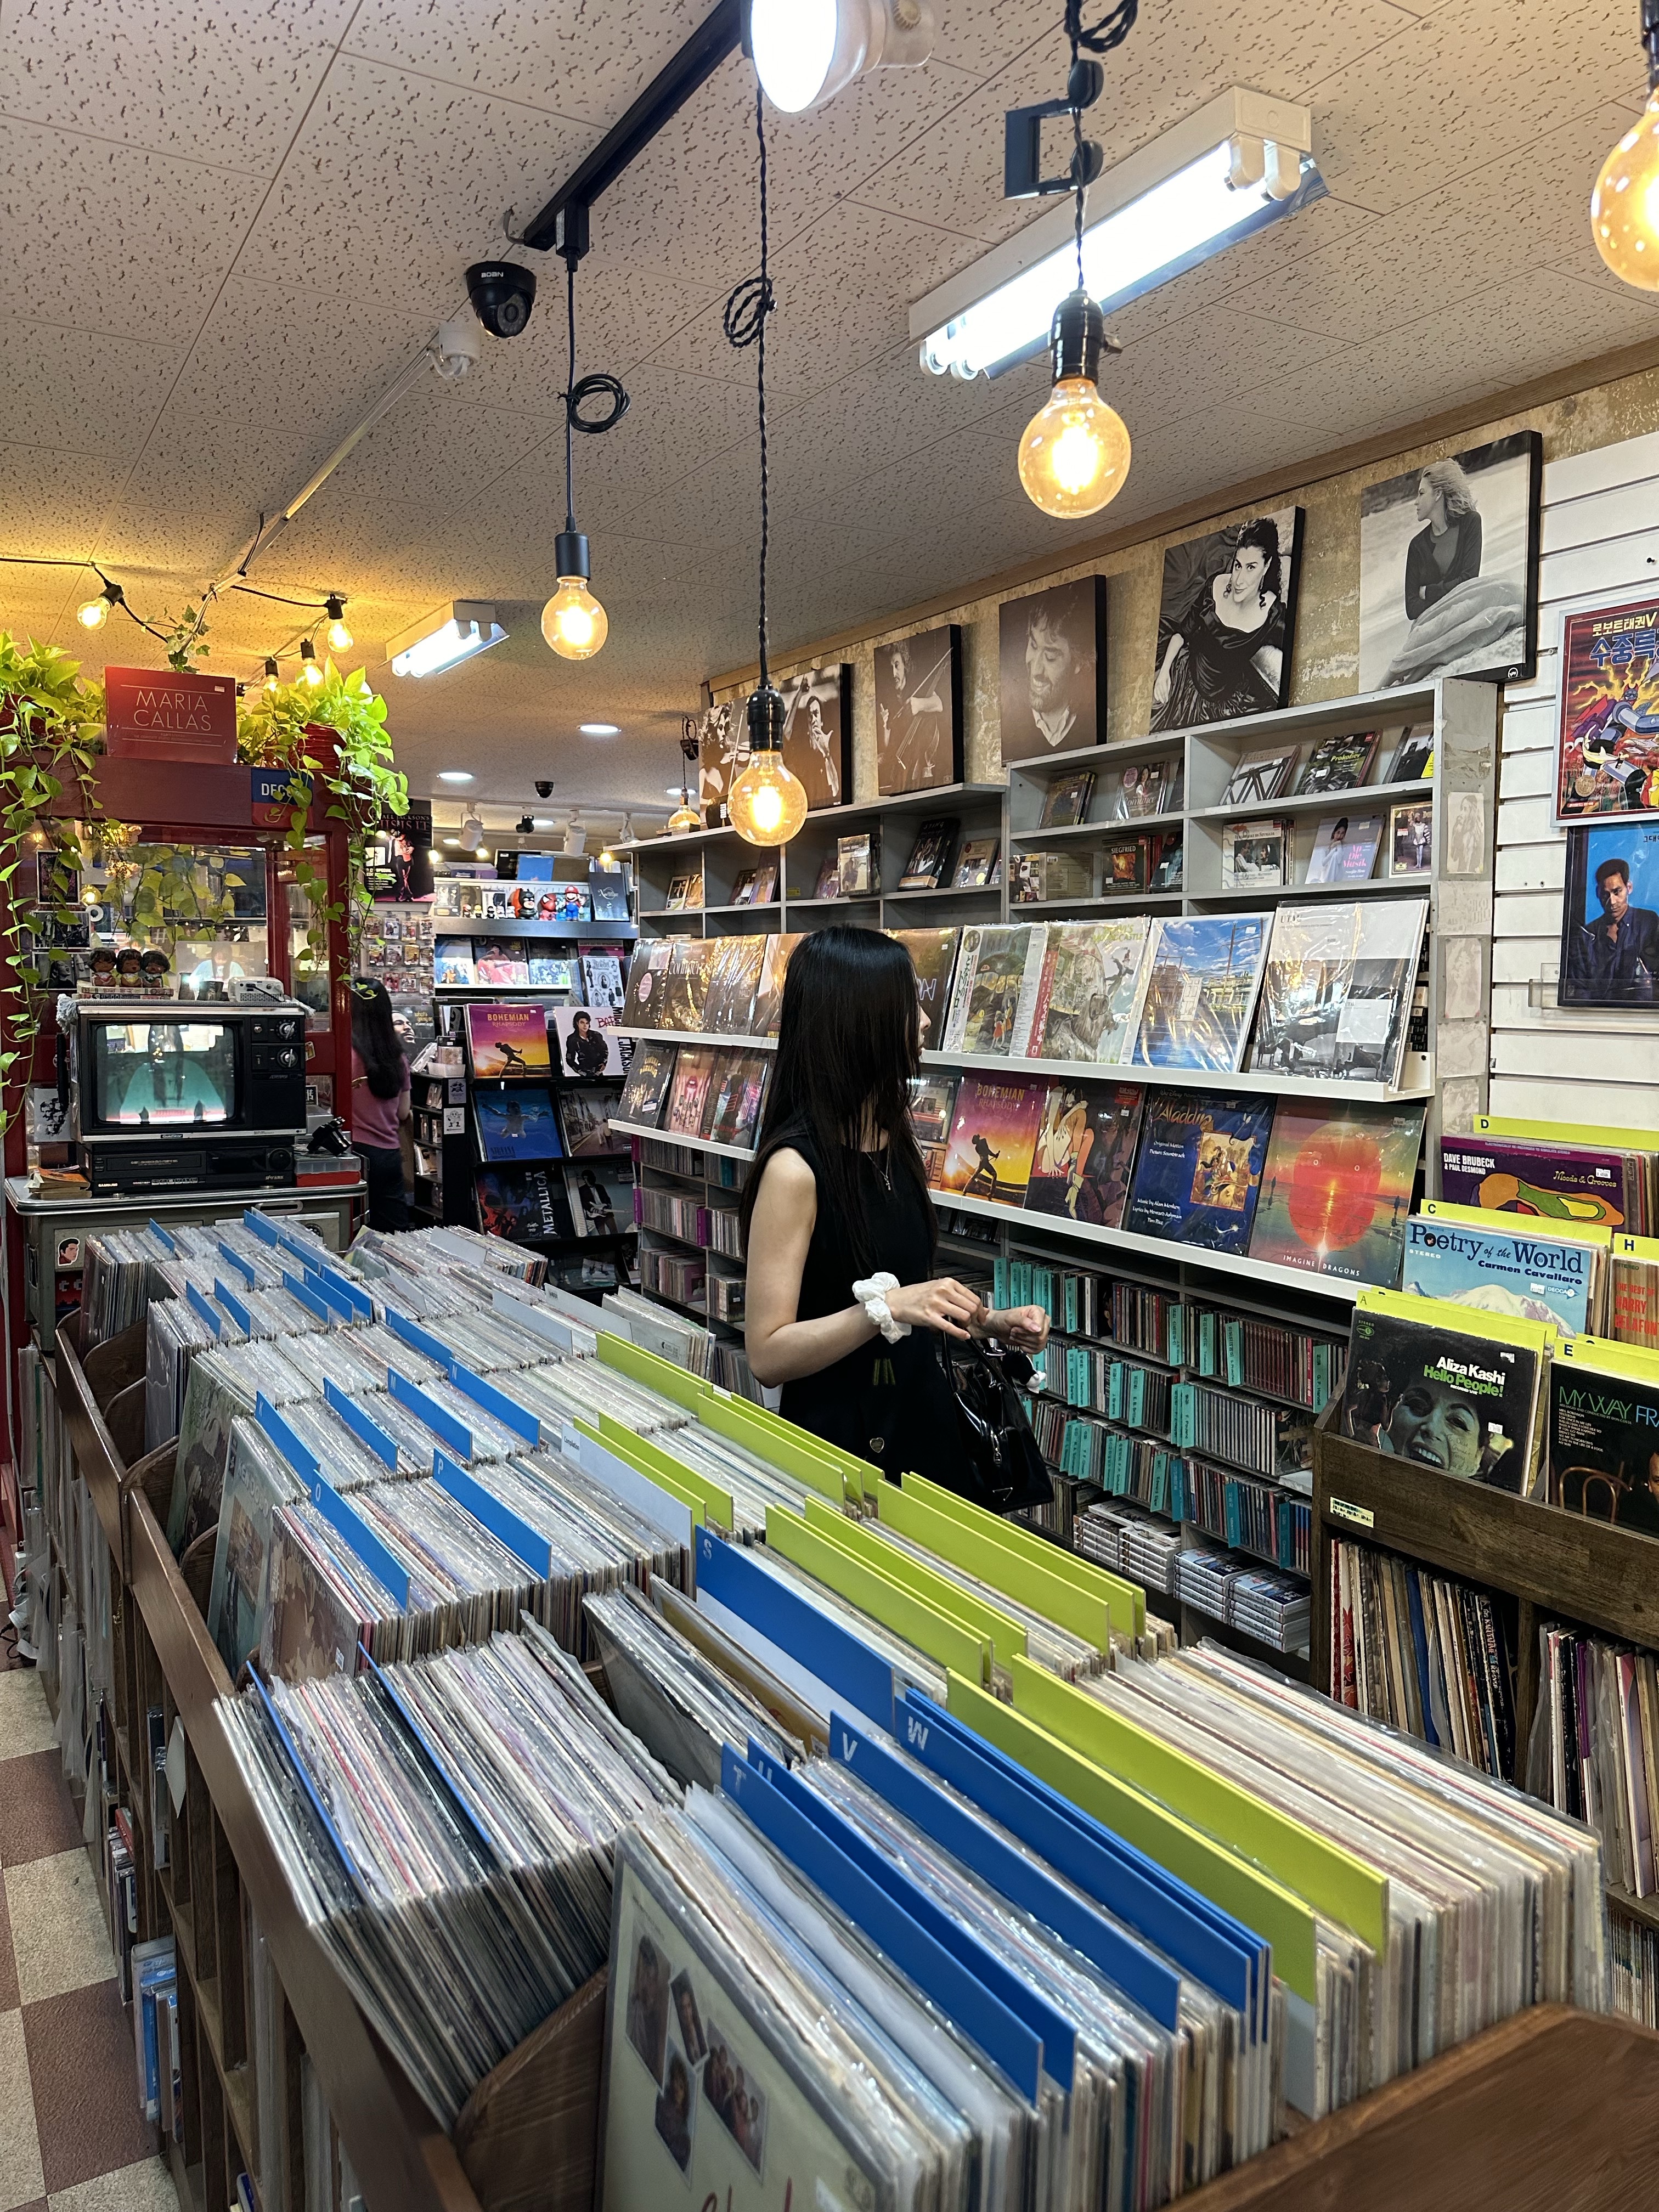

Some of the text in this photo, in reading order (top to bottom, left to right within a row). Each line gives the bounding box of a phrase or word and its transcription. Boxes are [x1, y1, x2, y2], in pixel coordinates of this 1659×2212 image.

[1592, 612, 1657, 636] 로보트태권V
[1589, 629, 1659, 668] 수중특
[136, 690, 207, 712] MARIA
[134, 709, 211, 731] CALLAS
[1331, 753, 1362, 762] Prokofiev
[1111, 845, 1137, 854] SIEGFRIED
[977, 1083, 1025, 1102] BOHEMIAN
[979, 1098, 1017, 1111] RHAPSODY
[1158, 1100, 1213, 1126] Aladdin
[1481, 1120, 1489, 1128] D
[1154, 1141, 1169, 1149] Original
[1443, 1153, 1495, 1169] DAVE BRUBECK
[1462, 1166, 1486, 1175] DESMOND
[1553, 1171, 1617, 1187] Moods & Grooves
[534, 1171, 557, 1235] METALLICA
[1164, 1202, 1180, 1210] Menken
[1427, 1204, 1436, 1214] C
[1409, 1223, 1583, 1274] Poetry of the World
[1624, 1239, 1634, 1251] H
[1409, 1249, 1441, 1259] STEREO
[1283, 1255, 1360, 1277] IMAGINE DRAGONS
[1478, 1260, 1583, 1285] Carmen Cavallaro
[1548, 1286, 1567, 1294] DECCA
[1617, 1283, 1655, 1297] THE BEST OF
[1360, 1295, 1367, 1305] A
[1615, 1295, 1647, 1314] HARRY
[1615, 1314, 1659, 1336] BELAFON
[1564, 1344, 1573, 1357] E
[452, 1365, 457, 1379] N
[1436, 1356, 1506, 1385] Aliza Kashi
[391, 1376, 396, 1390] M
[1424, 1364, 1504, 1397] Hello People!
[1560, 1386, 1633, 1420] MY WAY
[563, 1436, 580, 1451] Compilation
[438, 1458, 443, 1474] P
[314, 1483, 321, 1502] O
[703, 1538, 712, 1560] S
[908, 1716, 929, 1751] W
[843, 1731, 857, 1762] V
[733, 1764, 747, 1793] T
